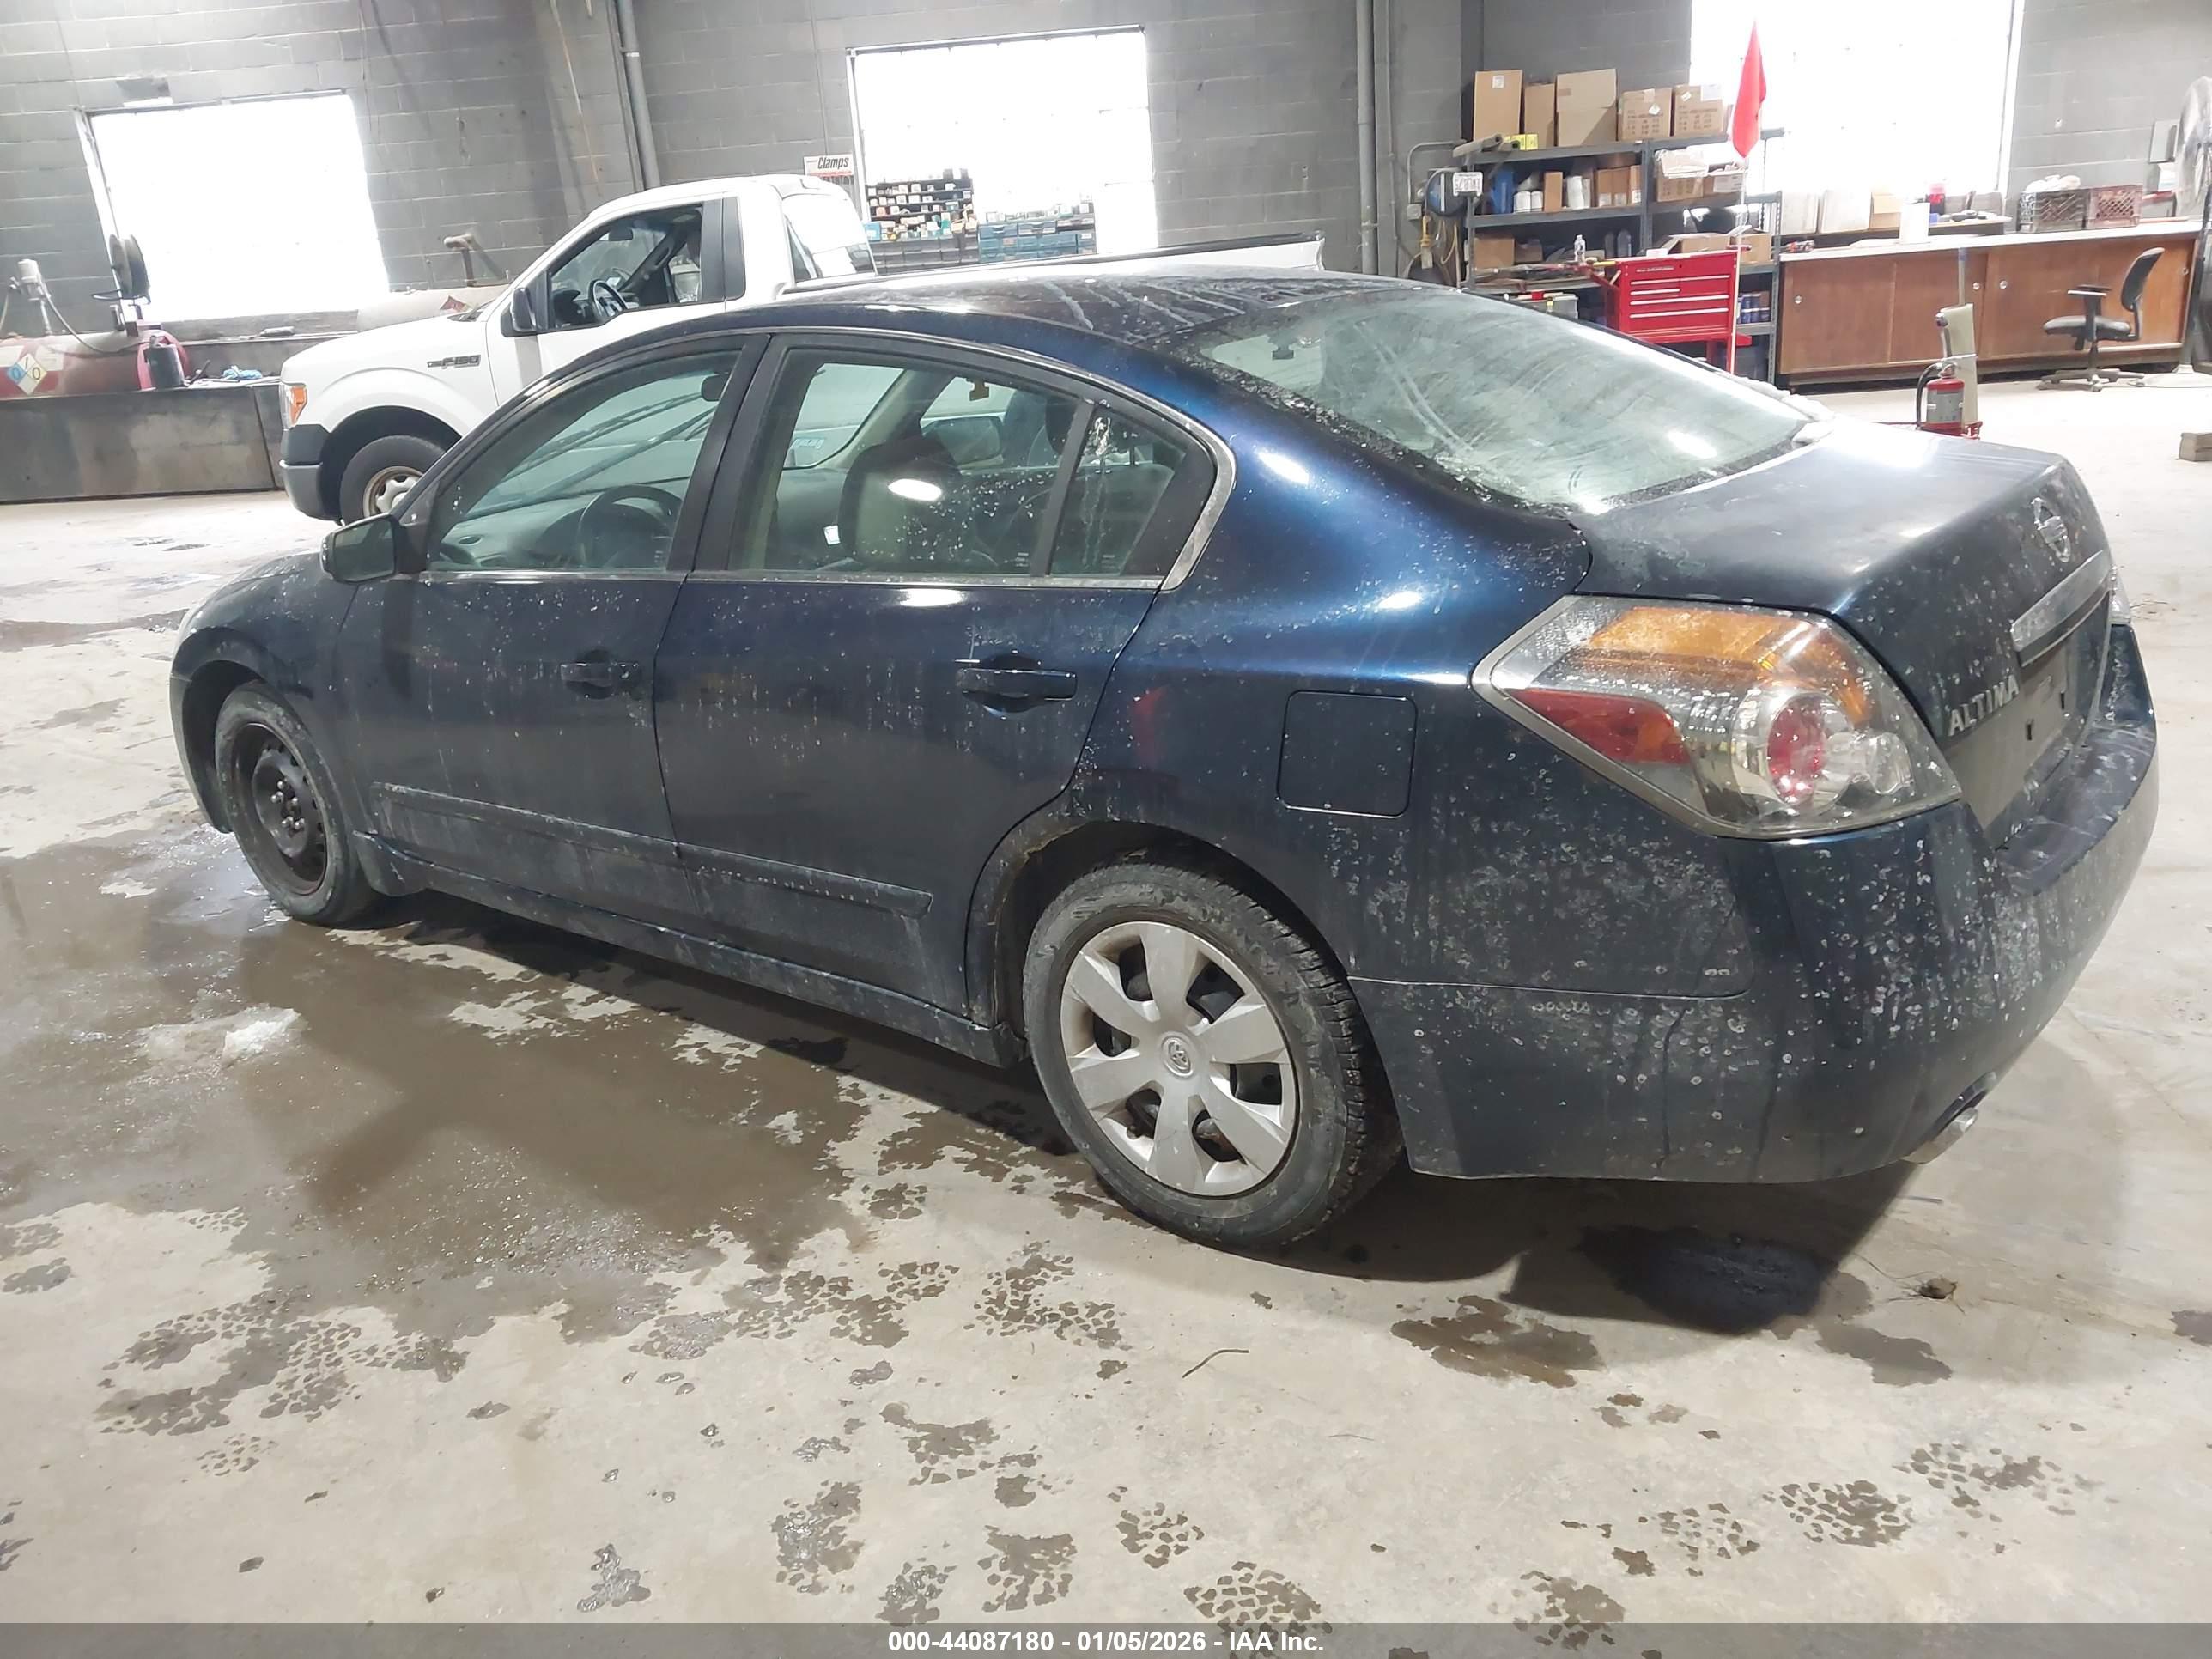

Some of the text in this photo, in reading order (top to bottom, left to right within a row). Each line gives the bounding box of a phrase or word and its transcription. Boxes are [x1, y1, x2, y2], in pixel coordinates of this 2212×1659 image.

[817, 156, 849, 170] Clamps
[32, 367, 41, 380] 0
[1948, 674, 2020, 737] ALTIMA
